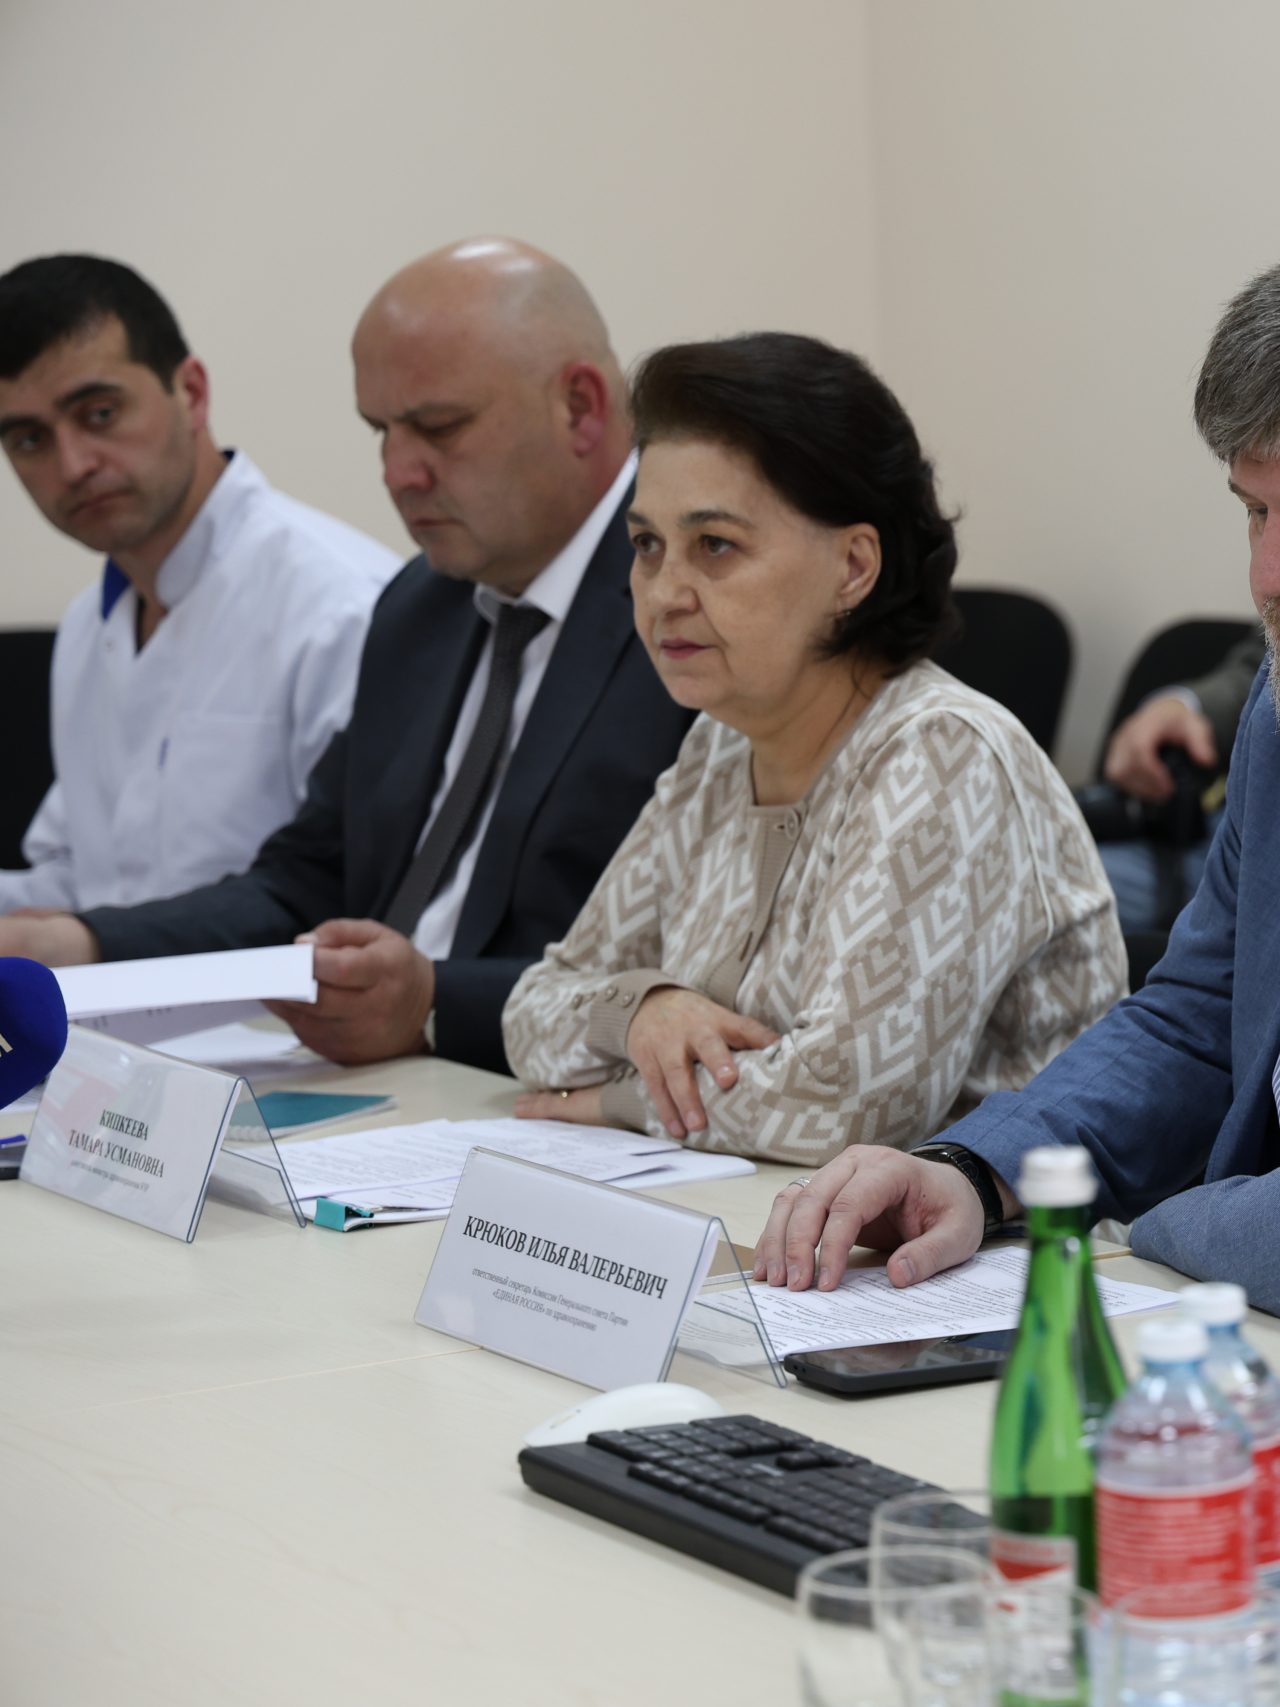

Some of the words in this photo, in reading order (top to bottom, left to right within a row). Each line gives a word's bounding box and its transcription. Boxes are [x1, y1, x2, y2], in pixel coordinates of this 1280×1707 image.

[68, 1129, 105, 1156] ТАМАРА
[104, 1142, 165, 1178] УСМАНОВНА
[462, 1215, 527, 1253] КРЮКОВ
[526, 1236, 570, 1267] ИЛЬЯ
[568, 1249, 668, 1299] ВАЛЕРЬЕВИЧ
